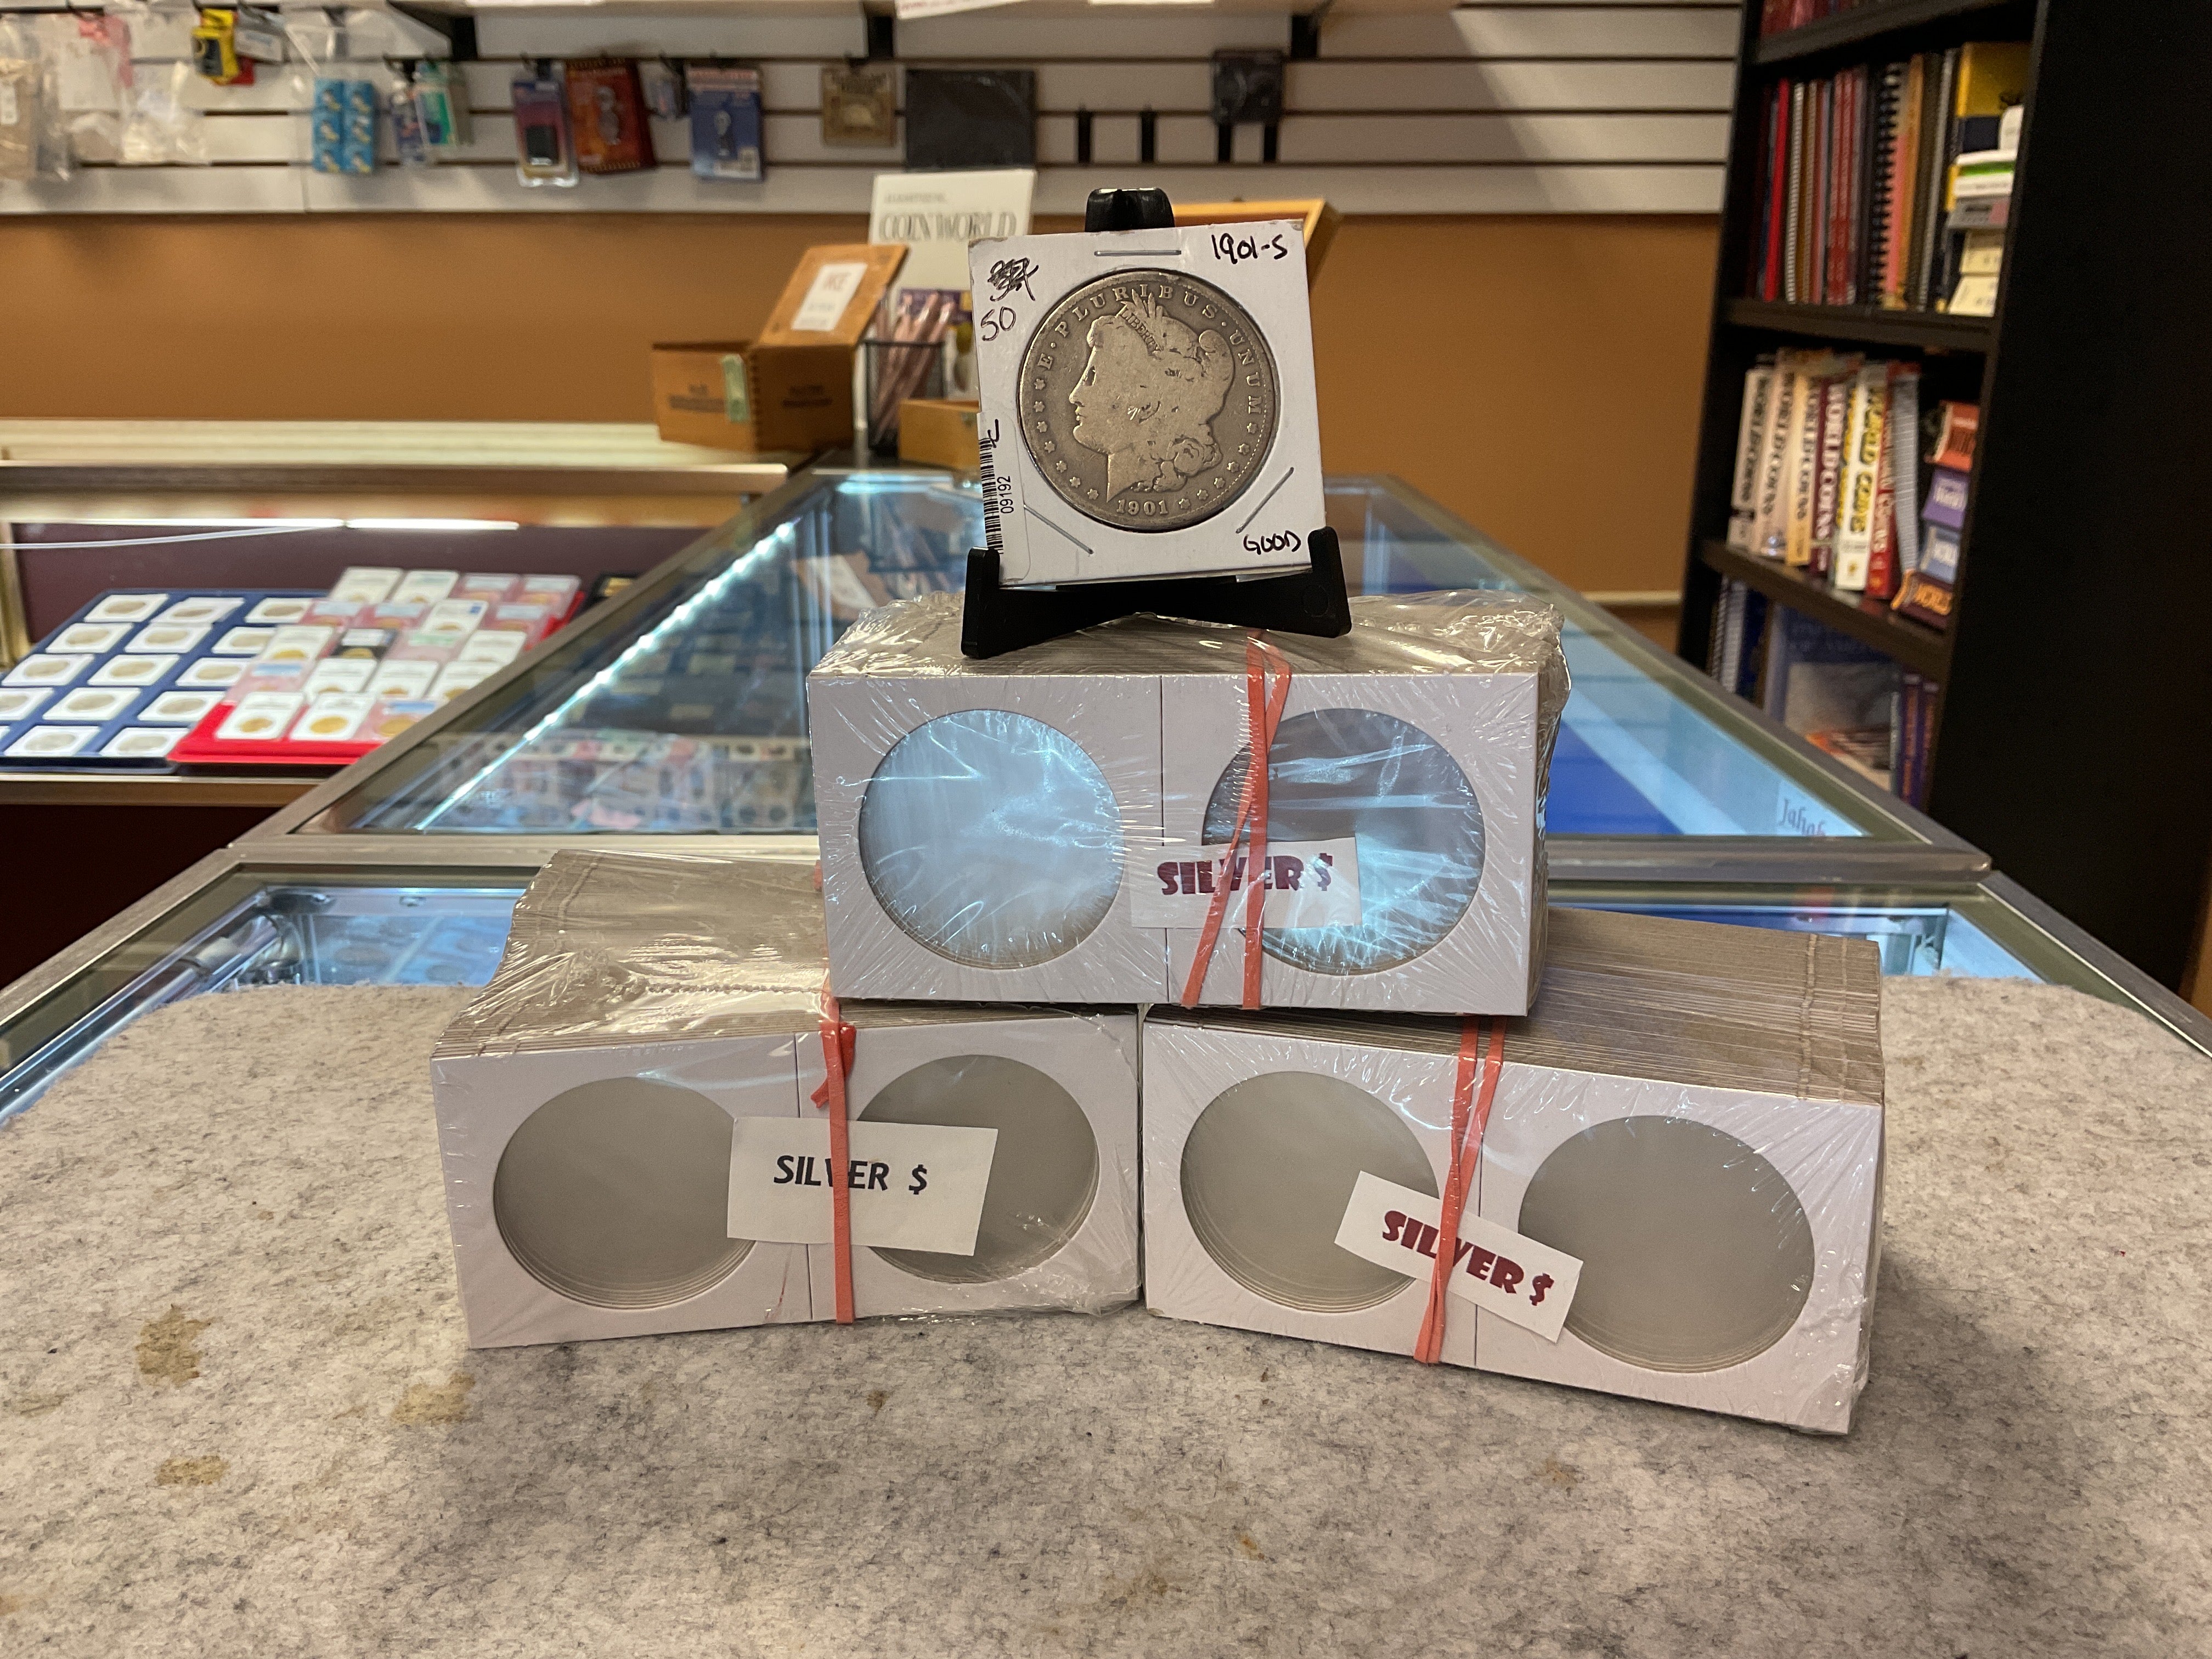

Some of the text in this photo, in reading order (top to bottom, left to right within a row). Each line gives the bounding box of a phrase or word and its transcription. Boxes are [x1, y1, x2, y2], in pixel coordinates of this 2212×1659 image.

[879, 211, 1017, 241] COIN WORLD
[1212, 233, 1288, 266] 1901-S
[1119, 307, 1163, 354] LIBERTY
[1054, 283, 1218, 339] PLURIBUS
[1229, 330, 1264, 416] UNUM
[1001, 476, 1014, 514] 09192
[1117, 498, 1169, 516] 1901
[1243, 535, 1302, 554] GOOD
[909, 1164, 927, 1195] $
[1529, 1273, 1555, 1306] $
